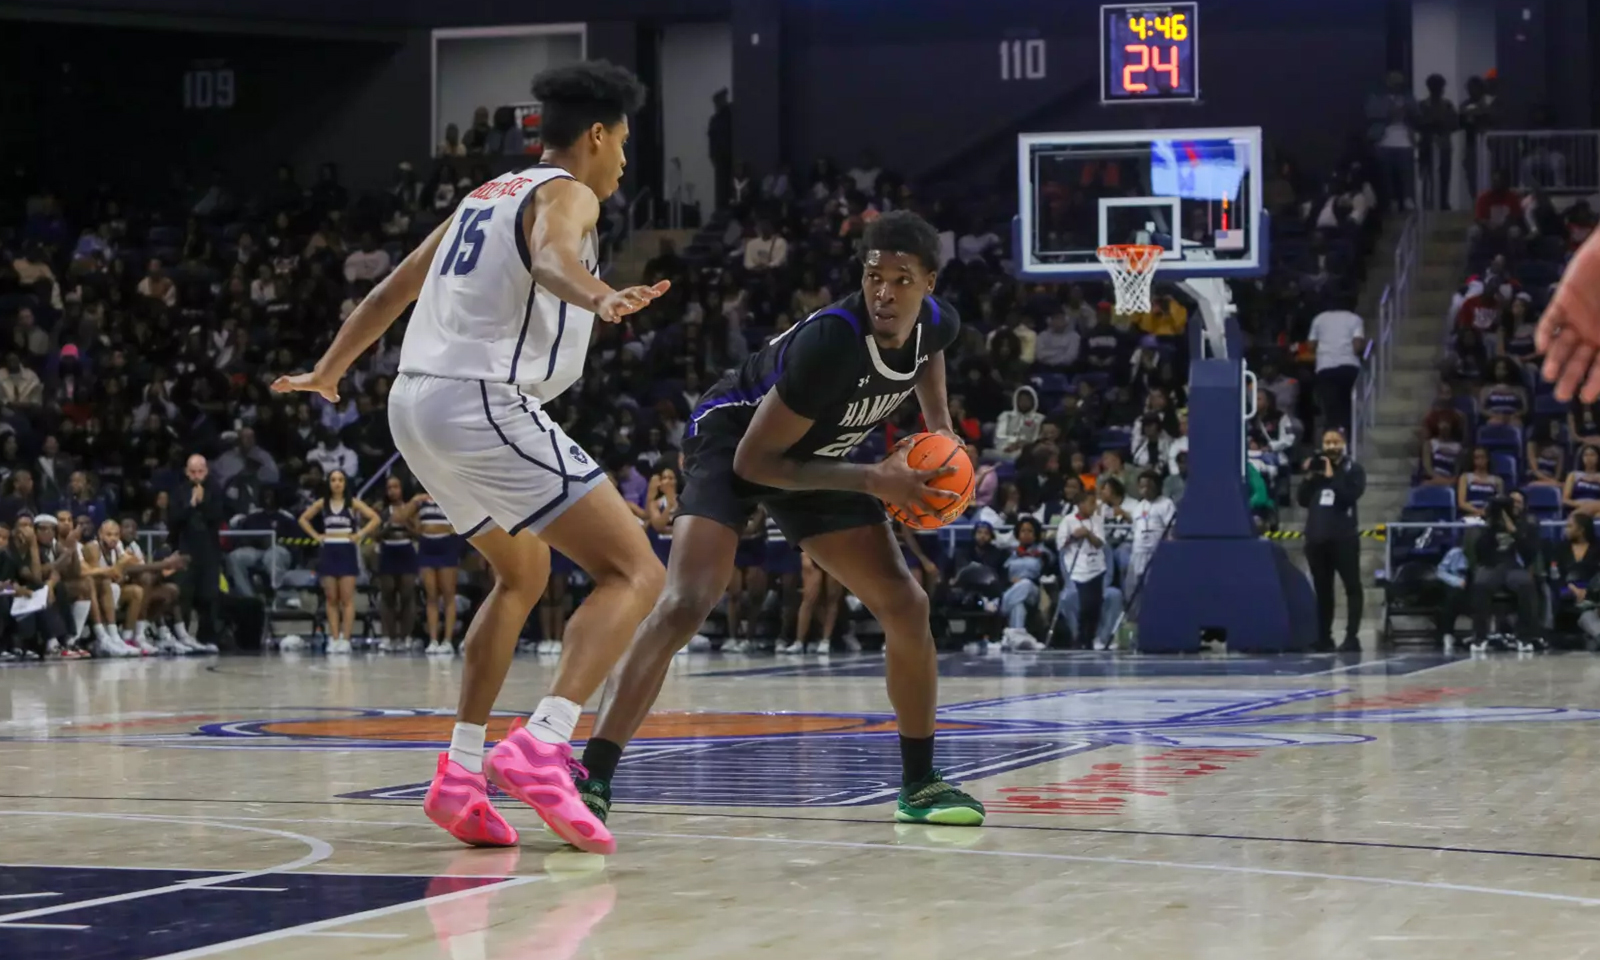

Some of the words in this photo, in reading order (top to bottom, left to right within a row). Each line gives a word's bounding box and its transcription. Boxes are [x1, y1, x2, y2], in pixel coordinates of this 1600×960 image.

[1129, 13, 1188, 41] 4:46
[1000, 39, 1046, 80] 110
[1123, 44, 1179, 91] 24
[183, 69, 235, 108] 109
[440, 206, 495, 275] 15
